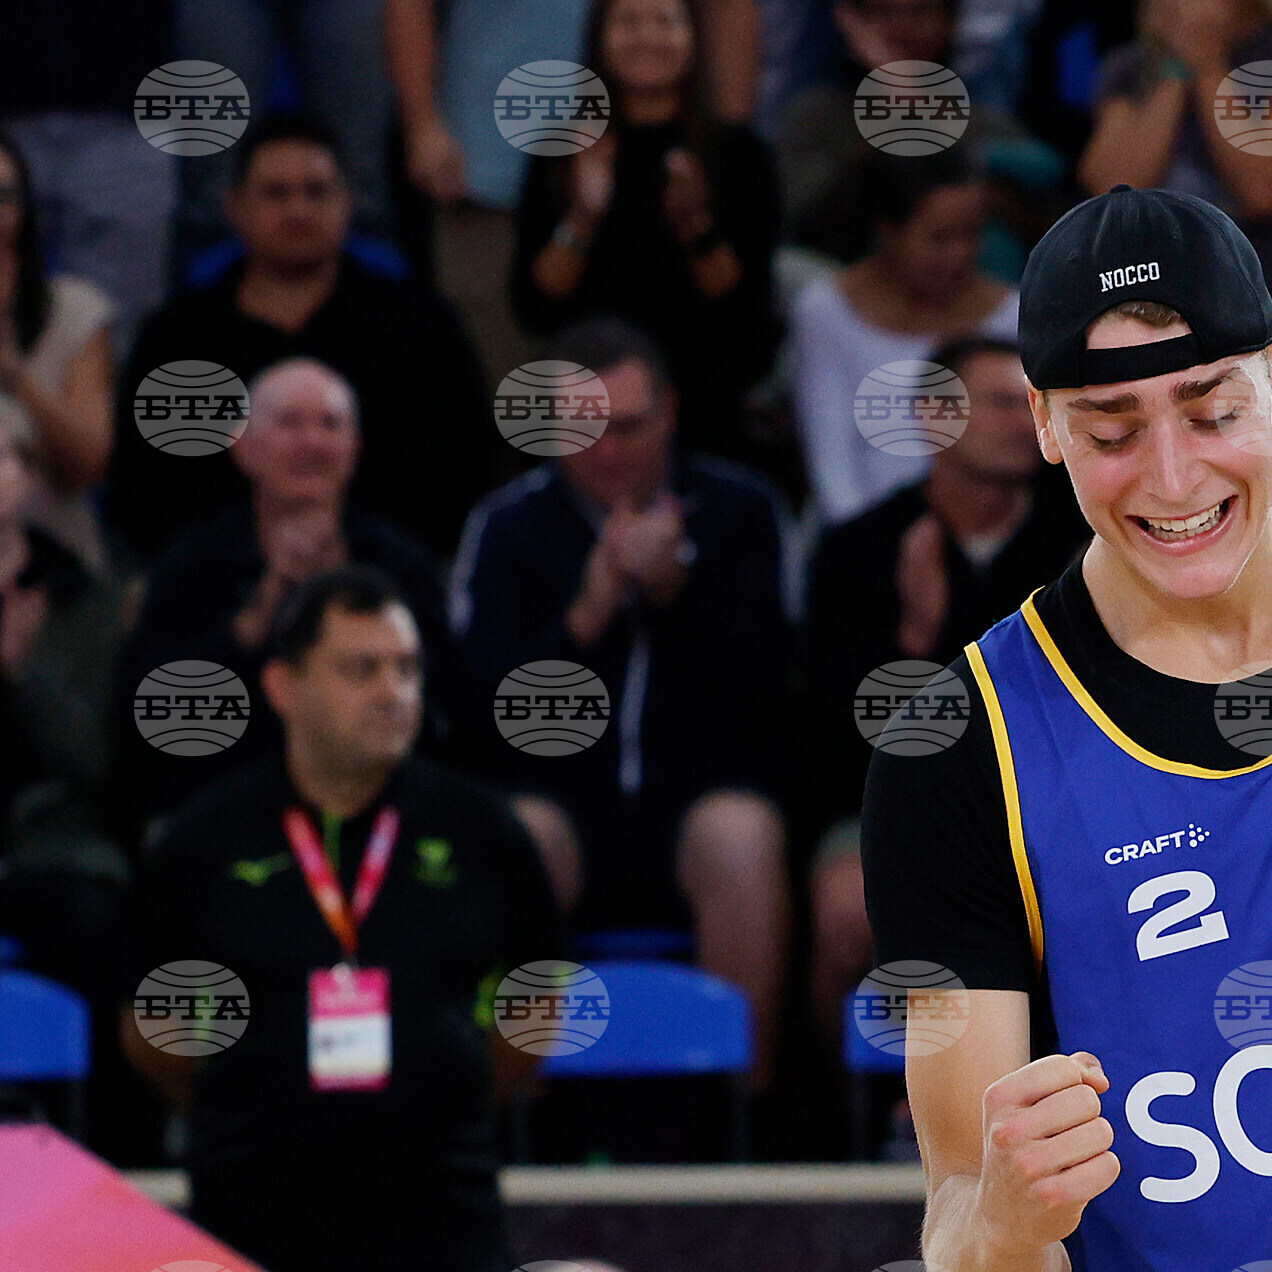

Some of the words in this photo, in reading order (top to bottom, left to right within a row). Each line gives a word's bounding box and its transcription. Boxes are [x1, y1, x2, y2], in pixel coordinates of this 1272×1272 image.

[1099, 262, 1160, 292] NOCCO
[1105, 829, 1186, 865] CRAFT
[1127, 870, 1229, 961] 2
